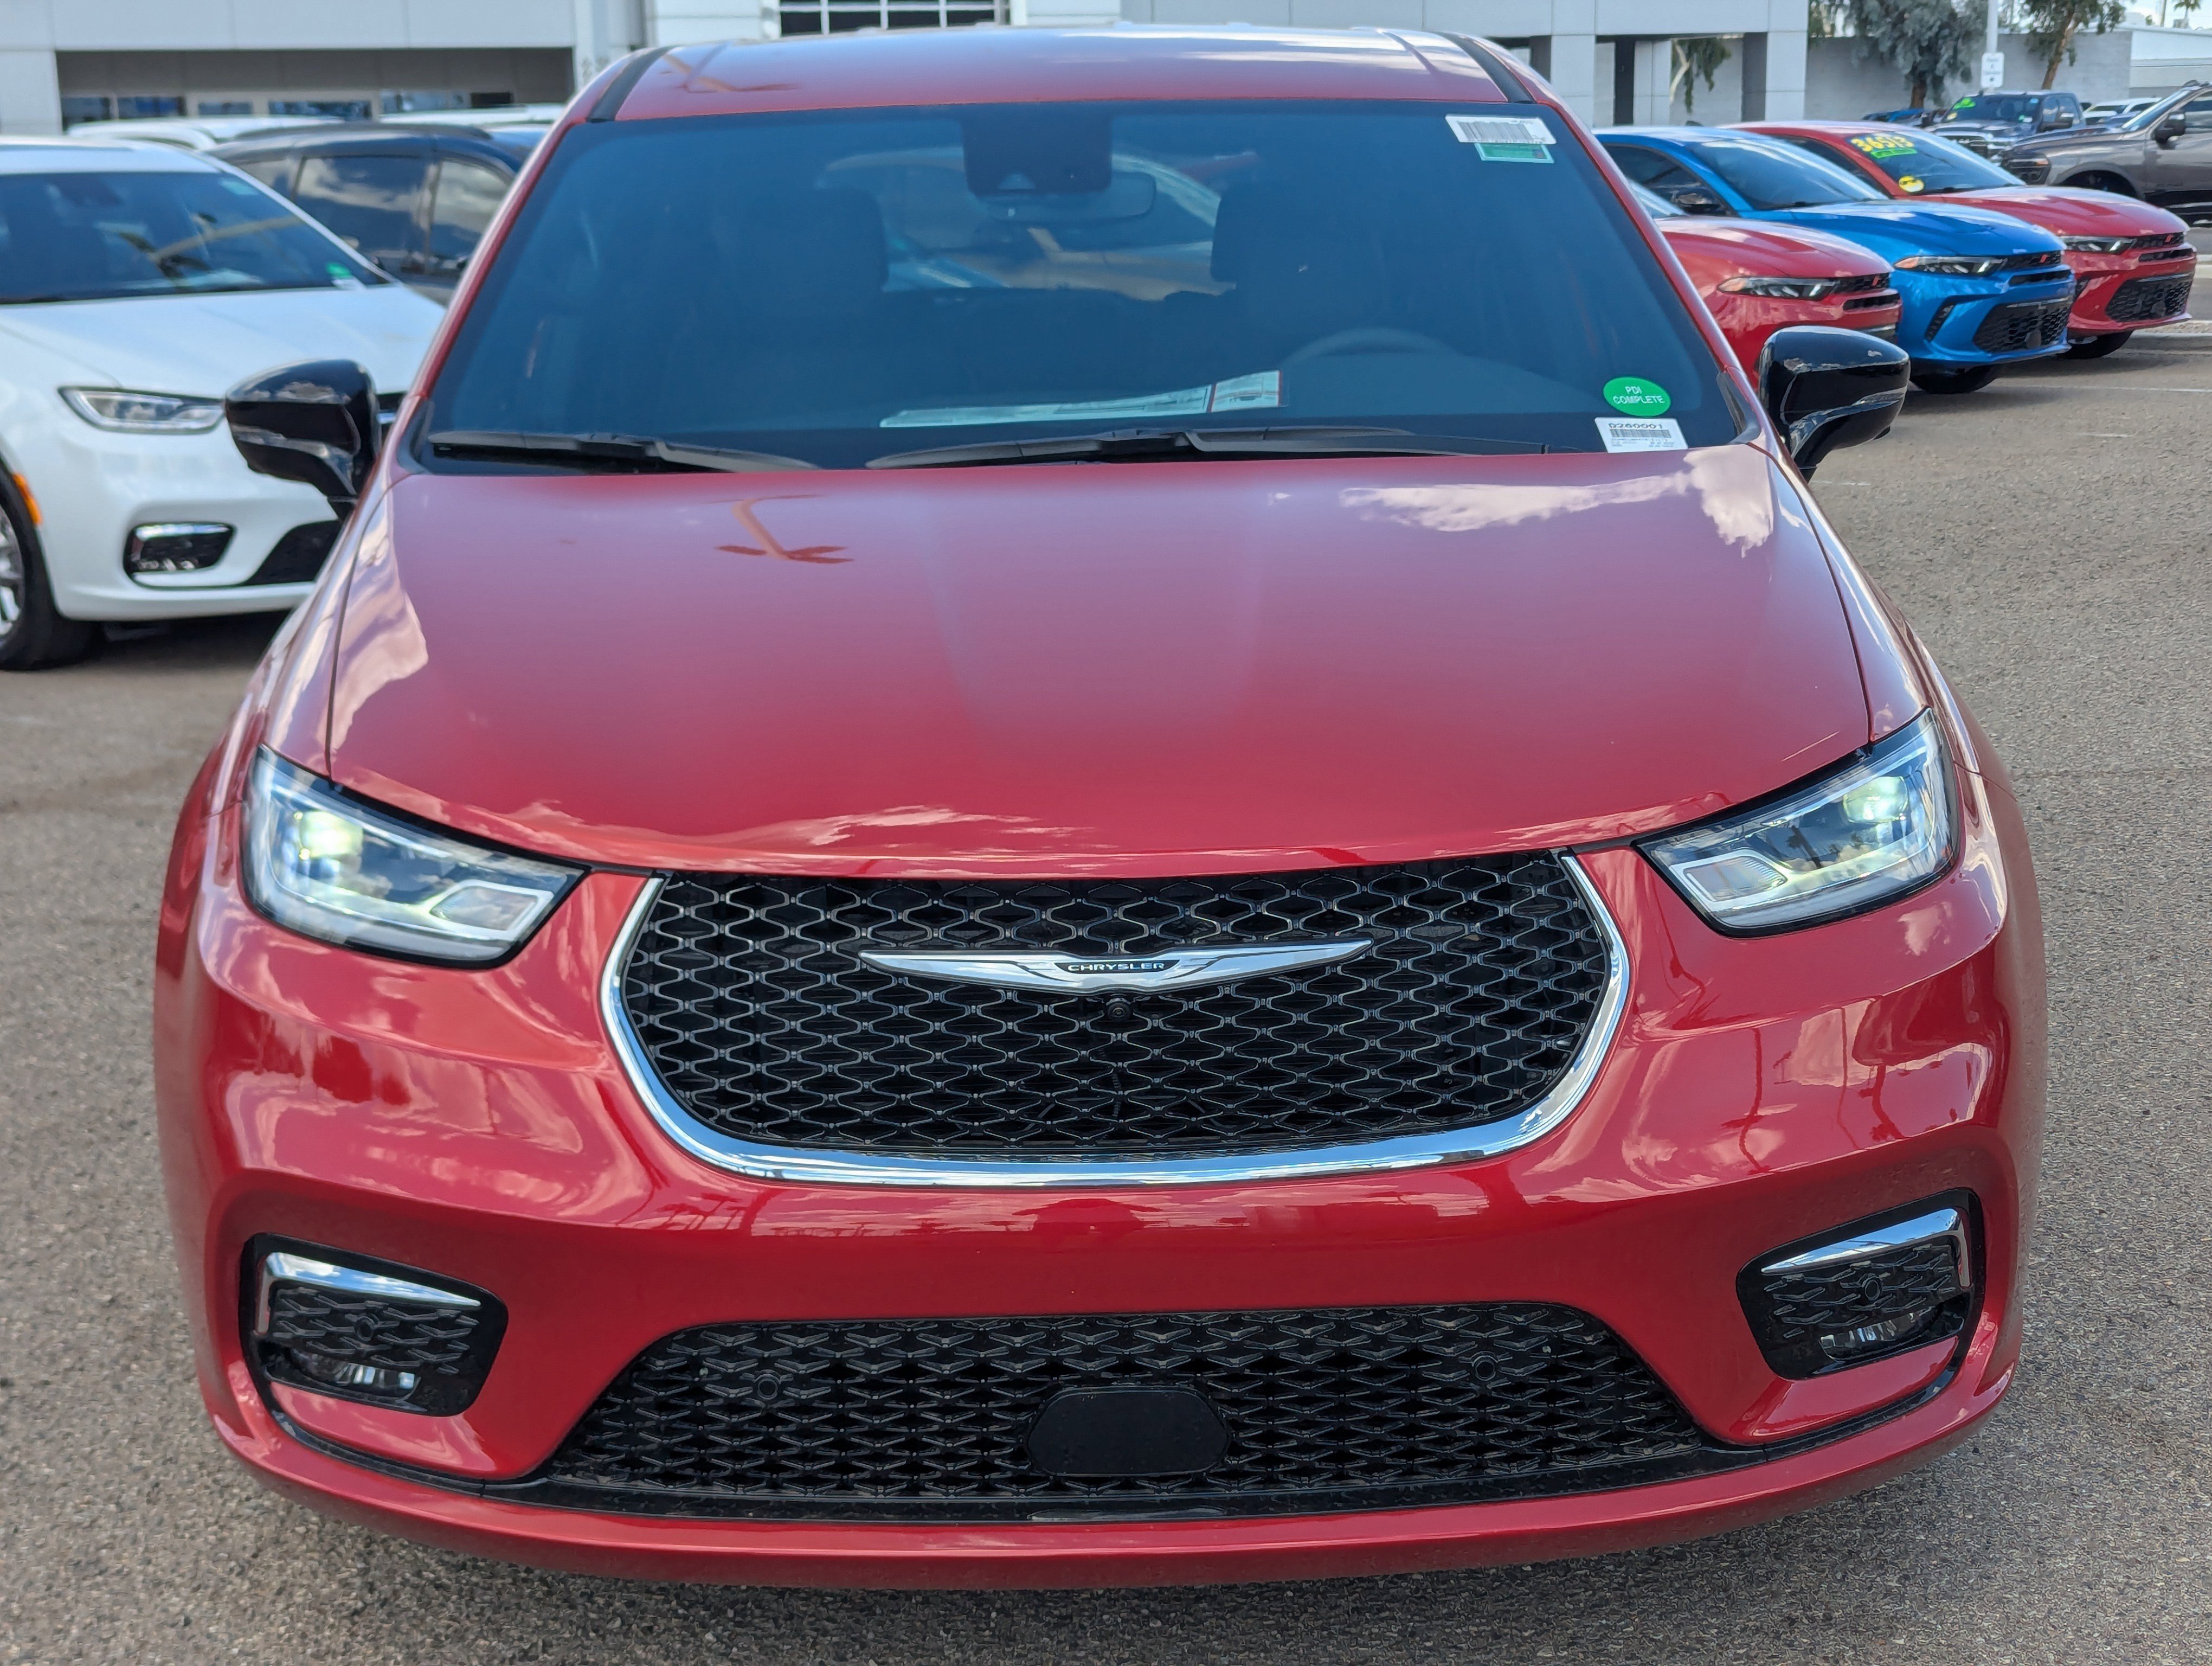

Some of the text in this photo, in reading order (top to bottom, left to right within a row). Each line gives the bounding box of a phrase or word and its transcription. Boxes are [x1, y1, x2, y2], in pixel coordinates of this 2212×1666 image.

[1625, 386, 1642, 395] PDI
[1612, 395, 1665, 404] COMPLETE
[1068, 963, 1165, 972] CHRYSLER
